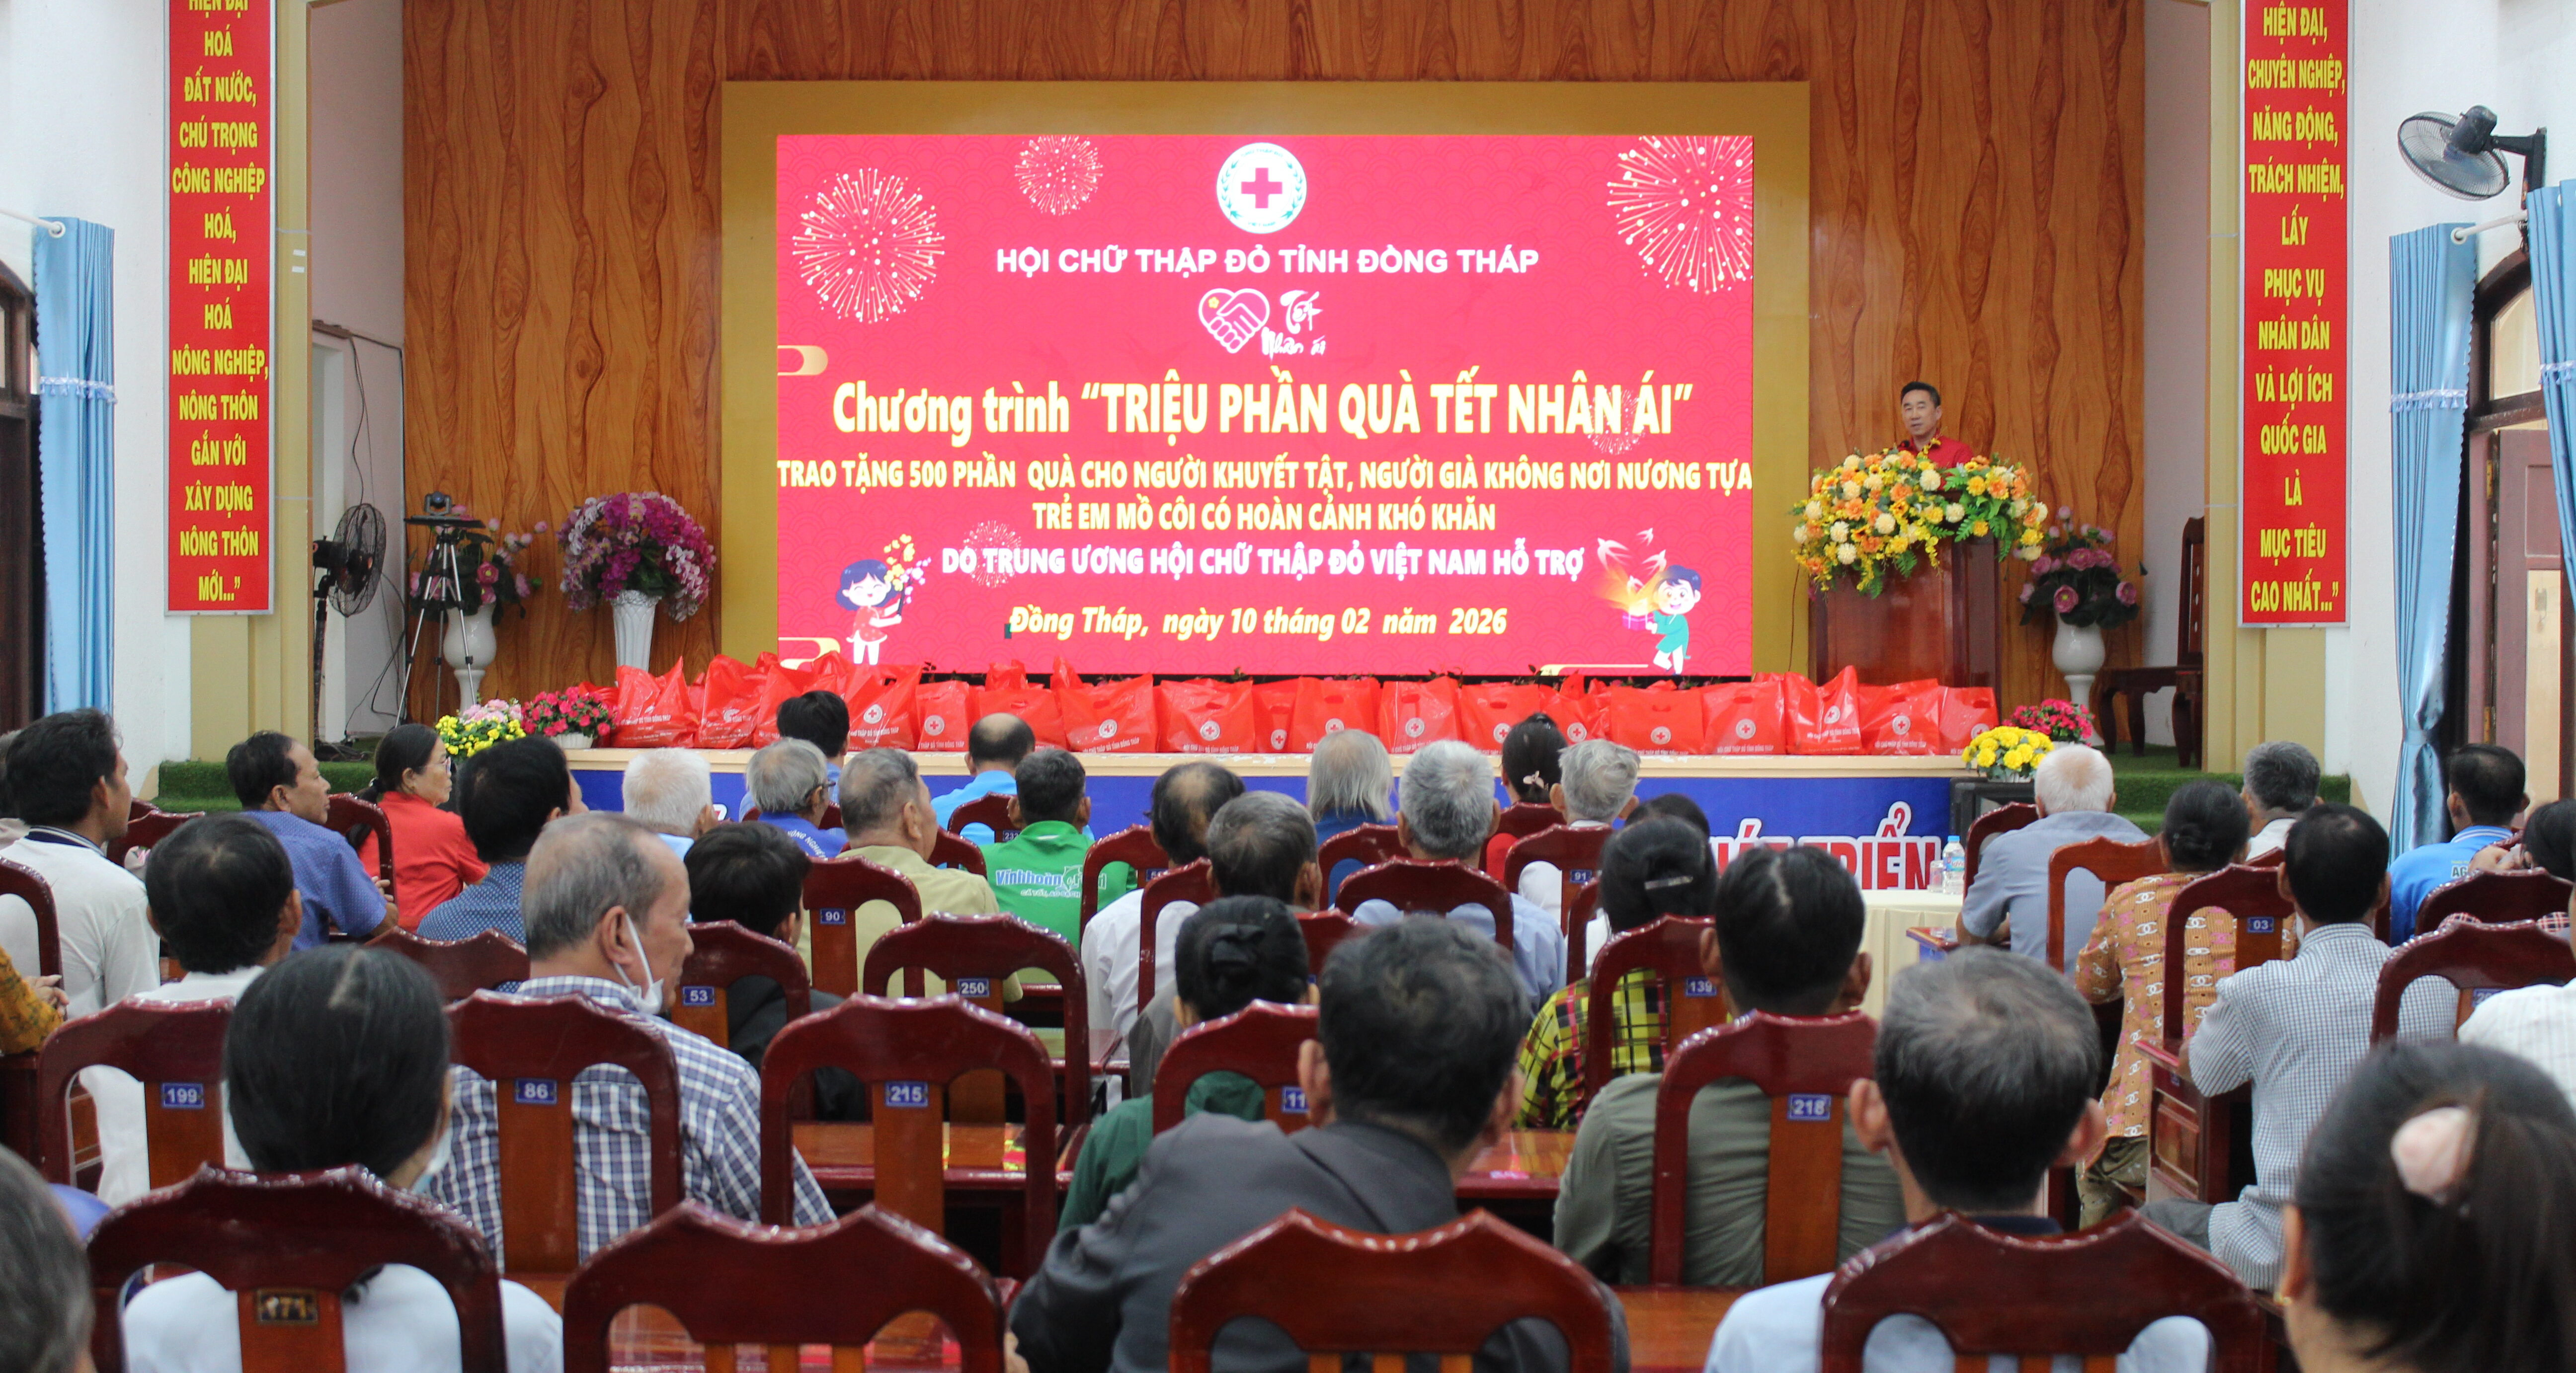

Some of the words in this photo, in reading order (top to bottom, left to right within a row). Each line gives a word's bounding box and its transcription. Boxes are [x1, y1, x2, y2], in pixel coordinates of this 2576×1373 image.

[205, 24, 233, 57] HOÁ
[2263, 0, 2296, 45] HIỆN
[2300, 7, 2327, 45] ĐẠI,
[184, 66, 211, 101] ĐẤT
[216, 70, 256, 107] NƯỚC,
[2248, 53, 2295, 89] CHUYÊN
[2299, 53, 2345, 97] NGHIỆP,
[179, 115, 207, 148] CHÚ
[211, 122, 257, 155] TRỌNG
[2253, 105, 2292, 141] NĂNG
[2296, 105, 2337, 150] ĐỘNG,
[172, 162, 210, 193] CÔNG
[214, 162, 265, 200] NGHIỆP
[2249, 156, 2293, 193] TRÁCH
[2298, 157, 2343, 202] NHIỆM,
[205, 206, 236, 243] HOÁ,
[2282, 204, 2308, 245] LẤY
[189, 253, 221, 291] HIỆN
[225, 259, 247, 291] ĐẠI
[997, 247, 1049, 278] HỘI
[1058, 245, 1127, 272] CHỮ
[1135, 247, 1216, 278] THẬP
[1224, 244, 1270, 273] ĐỎ
[1279, 244, 1348, 273] TỈNH
[1357, 244, 1448, 273] ĐỒNG
[1456, 244, 1538, 273] THÁP
[2264, 268, 2302, 306] PHỤC
[2306, 269, 2324, 306] VỤ
[204, 297, 233, 330] HOÁ
[1280, 290, 1323, 334] Tết
[2259, 314, 2297, 350] NHÂN
[2302, 314, 2330, 350] DÂN
[172, 344, 210, 375] NÔNG
[214, 344, 269, 382] NGHIỆP,
[179, 389, 217, 420] NÔNG
[221, 389, 257, 420] THÔN
[2255, 365, 2275, 401] VÀ
[2280, 368, 2303, 410] LỢI
[2308, 365, 2332, 402] ÍCH
[833, 381, 972, 448] Chương
[982, 381, 1069, 433] trình
[1081, 369, 1208, 446] “TRIỆU
[1220, 365, 1327, 433] PHẦN
[1339, 369, 1421, 439] QUÀ
[1430, 366, 1498, 433] TẾT
[1508, 370, 1622, 434] NHÂN
[1632, 370, 1693, 434] ÁI”
[191, 430, 219, 465] GẮN
[223, 433, 245, 465] VỚI
[2261, 413, 2299, 455] QUỐC
[2303, 425, 2327, 454] GIA
[778, 460, 837, 487] TRAO
[841, 453, 903, 494] TẶNG
[910, 460, 947, 487] 500
[953, 451, 1016, 487] PHẦN
[1028, 454, 1075, 491] QUÀ
[1081, 460, 1127, 488] CHO
[1133, 454, 1207, 488] NGƯỜI
[1213, 452, 1299, 488] KHUYẾT
[1304, 454, 1353, 494] TẬT,
[1360, 454, 1433, 489] NGƯỜI
[1439, 454, 1478, 489] GIÀ
[1484, 455, 1564, 489] KHÔNG
[1570, 459, 1610, 489] NƠI
[1617, 458, 1700, 490] NƯƠNG
[1706, 458, 1752, 496] TỰA
[2285, 469, 2302, 505] LÀ
[185, 480, 212, 511] XÂY
[216, 481, 253, 518] DỰNG
[1032, 494, 1072, 529] TRẺ
[1078, 503, 1110, 530] EM
[1117, 494, 1153, 530] MỒ
[1159, 495, 1195, 530] CÔI
[1201, 496, 1231, 530] CÓ
[1237, 496, 1302, 530] HOÀN
[1308, 494, 1371, 531] CẢNH
[1378, 496, 1426, 531] KHÓ
[1432, 496, 1495, 531] KHĂN
[180, 525, 218, 556] NÔNG
[222, 525, 258, 556] THÔN
[2261, 529, 2290, 566] MỤC
[2294, 522, 2326, 558] TIÊU
[942, 547, 977, 574] DO
[982, 547, 1065, 575] TRUNG
[1072, 544, 1143, 574] ƯƠNG
[1150, 541, 1193, 580] HỘI
[1200, 542, 1253, 574] CHỮ
[1257, 542, 1324, 581] THẬP
[1328, 539, 1365, 575] ĐỎ
[1370, 542, 1423, 581] VIỆT
[1429, 549, 1486, 574] NAM
[1493, 537, 1529, 575] HỖ
[1534, 547, 1585, 582] TRỢ
[199, 569, 240, 601] MỚI...”
[2251, 581, 2279, 612] CAO
[2283, 568, 2338, 611] NHẤT...”
[1009, 604, 1074, 640] Đồng
[1082, 606, 1148, 640] Tháp,
[1162, 608, 1224, 641] ngày
[1231, 608, 1257, 633] 10
[1263, 607, 1335, 641] tháng
[1341, 608, 1370, 634] 02
[1382, 607, 1437, 634] năm
[1449, 608, 1507, 634] 2026
[825, 911, 841, 922] 90
[2253, 919, 2269, 930] 03
[689, 990, 709, 1002] 53
[961, 982, 985, 995] 250
[166, 1088, 198, 1104] 199
[523, 1083, 548, 1099] 86
[890, 1086, 923, 1102] 215
[1287, 1091, 1306, 1108] 11
[1793, 1099, 1825, 1115] 218
